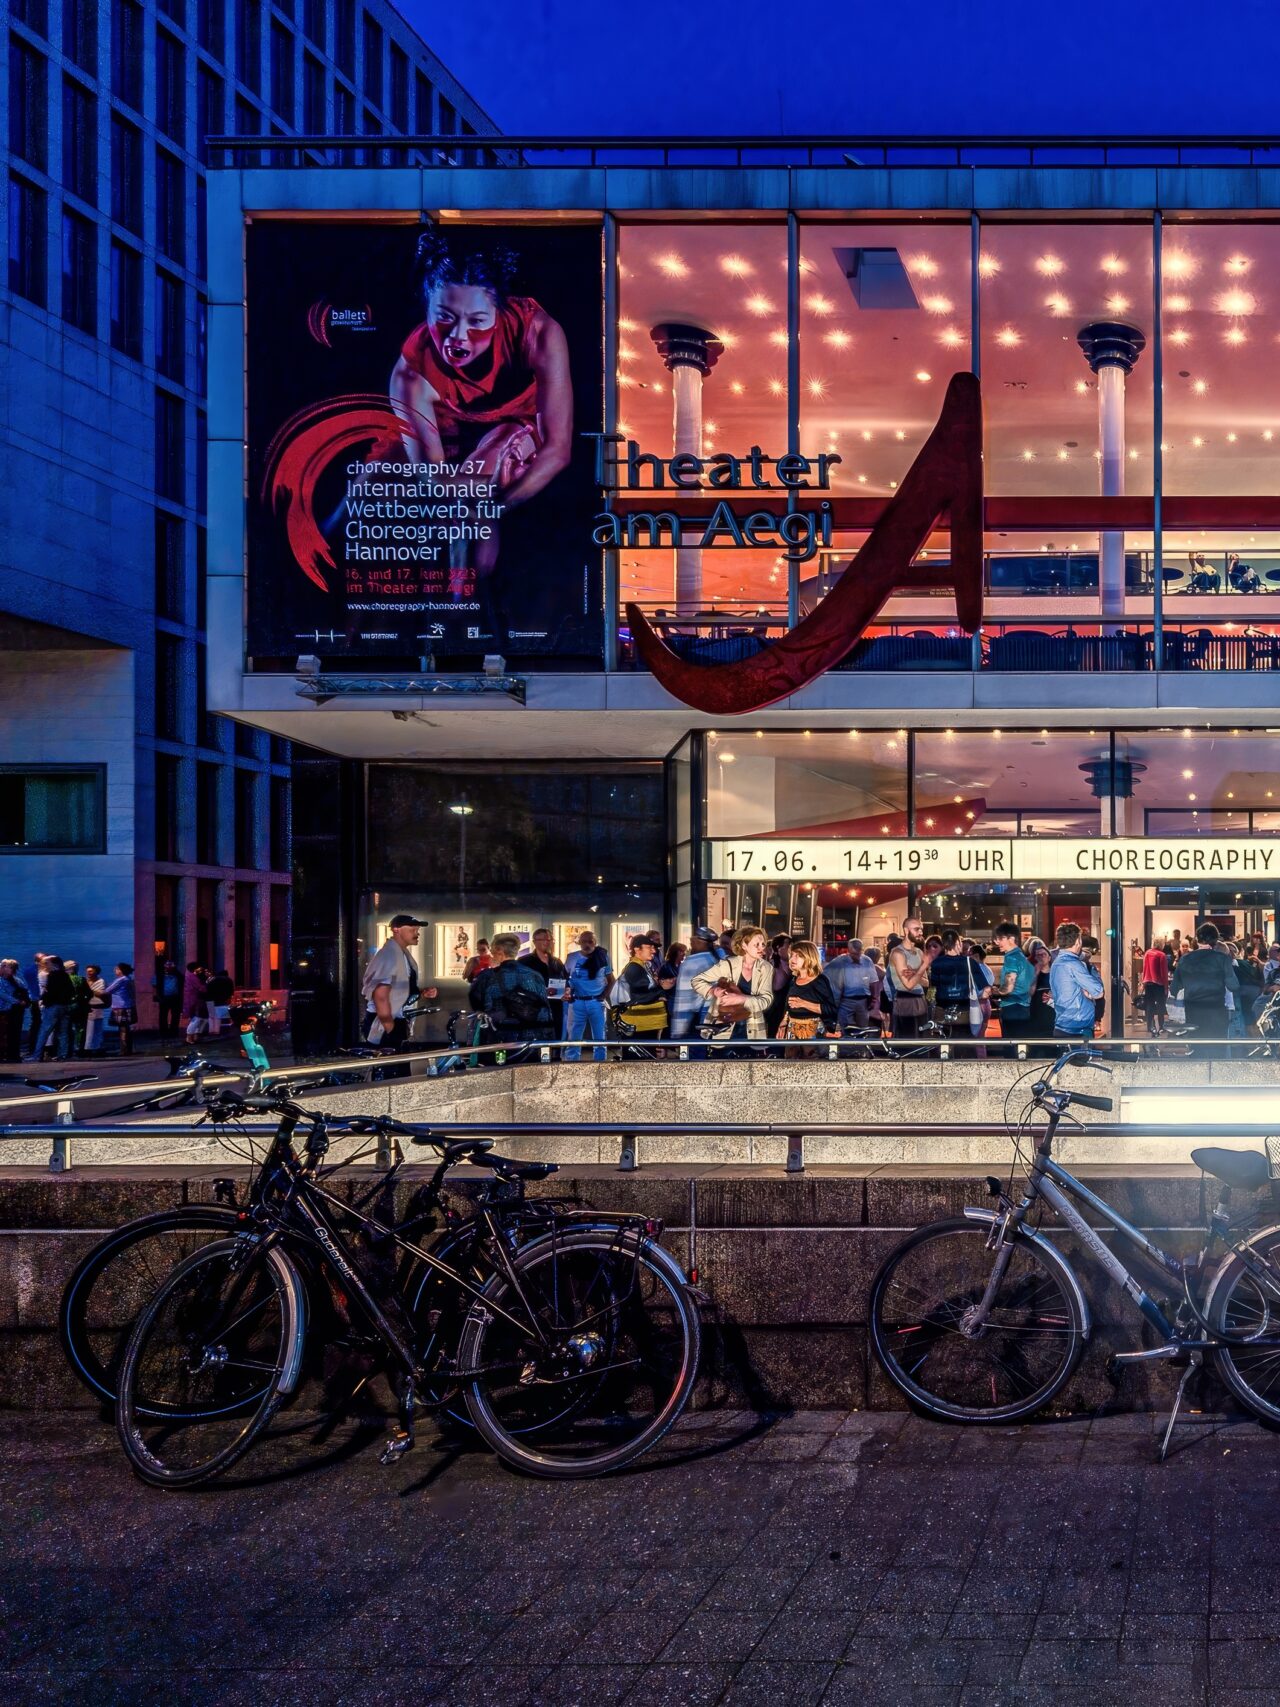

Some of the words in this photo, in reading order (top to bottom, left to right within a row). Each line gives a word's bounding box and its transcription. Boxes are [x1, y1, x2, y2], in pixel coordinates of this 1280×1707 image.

[347, 460, 459, 477] choreography
[464, 461, 486, 474] 37
[580, 433, 842, 489] Theater
[347, 479, 497, 498] Internationaler
[346, 500, 469, 518] Wettbewerb
[476, 500, 505, 518] für
[346, 521, 491, 544] Choreographie
[592, 511, 682, 546] am
[699, 501, 833, 562] Aegi
[345, 542, 441, 560] Hannover
[726, 850, 818, 872] 17.06.
[958, 850, 1004, 872] UHR
[1076, 849, 1274, 870] CHOREOGRAPHY
